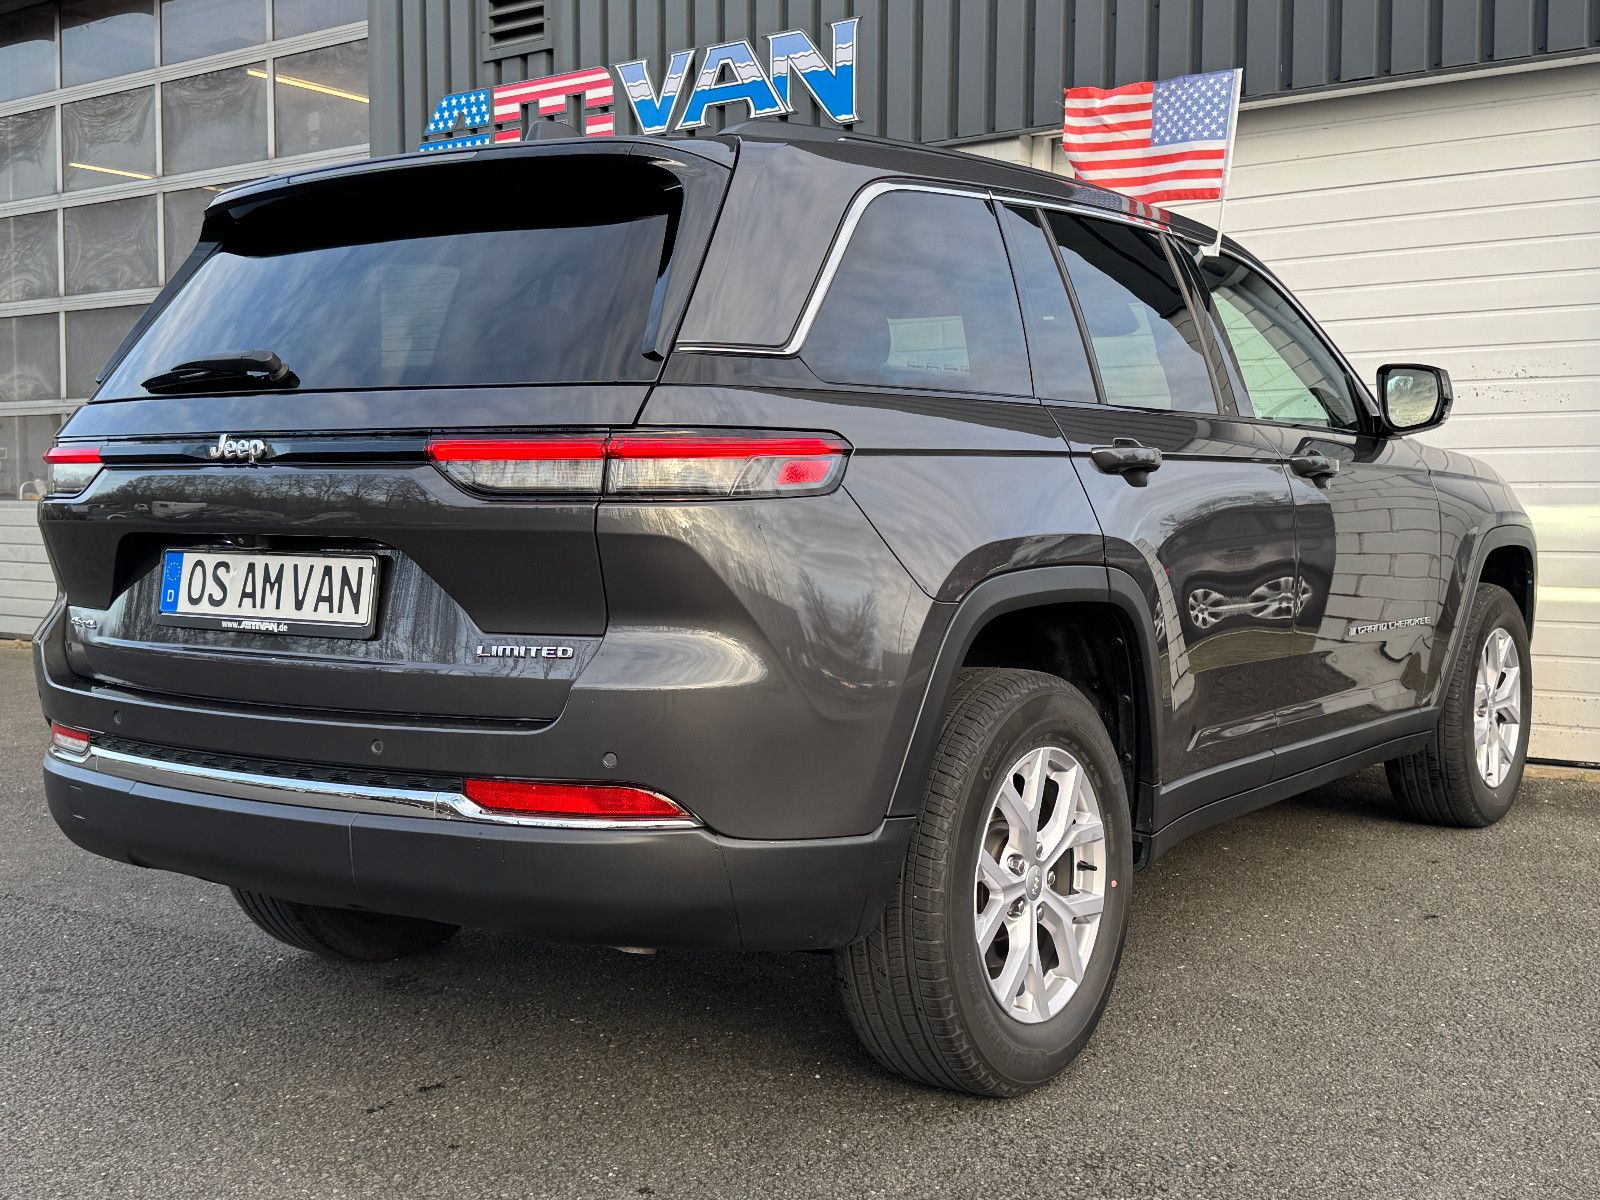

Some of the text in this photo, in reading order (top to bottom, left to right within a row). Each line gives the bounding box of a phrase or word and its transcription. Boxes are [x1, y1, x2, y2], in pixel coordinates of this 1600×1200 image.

[209, 433, 266, 463] Jeep
[187, 559, 231, 607] OS
[166, 589, 175, 602] D
[1358, 616, 1431, 635] GRAND CHEROKEE
[476, 645, 574, 659] LIMITED
